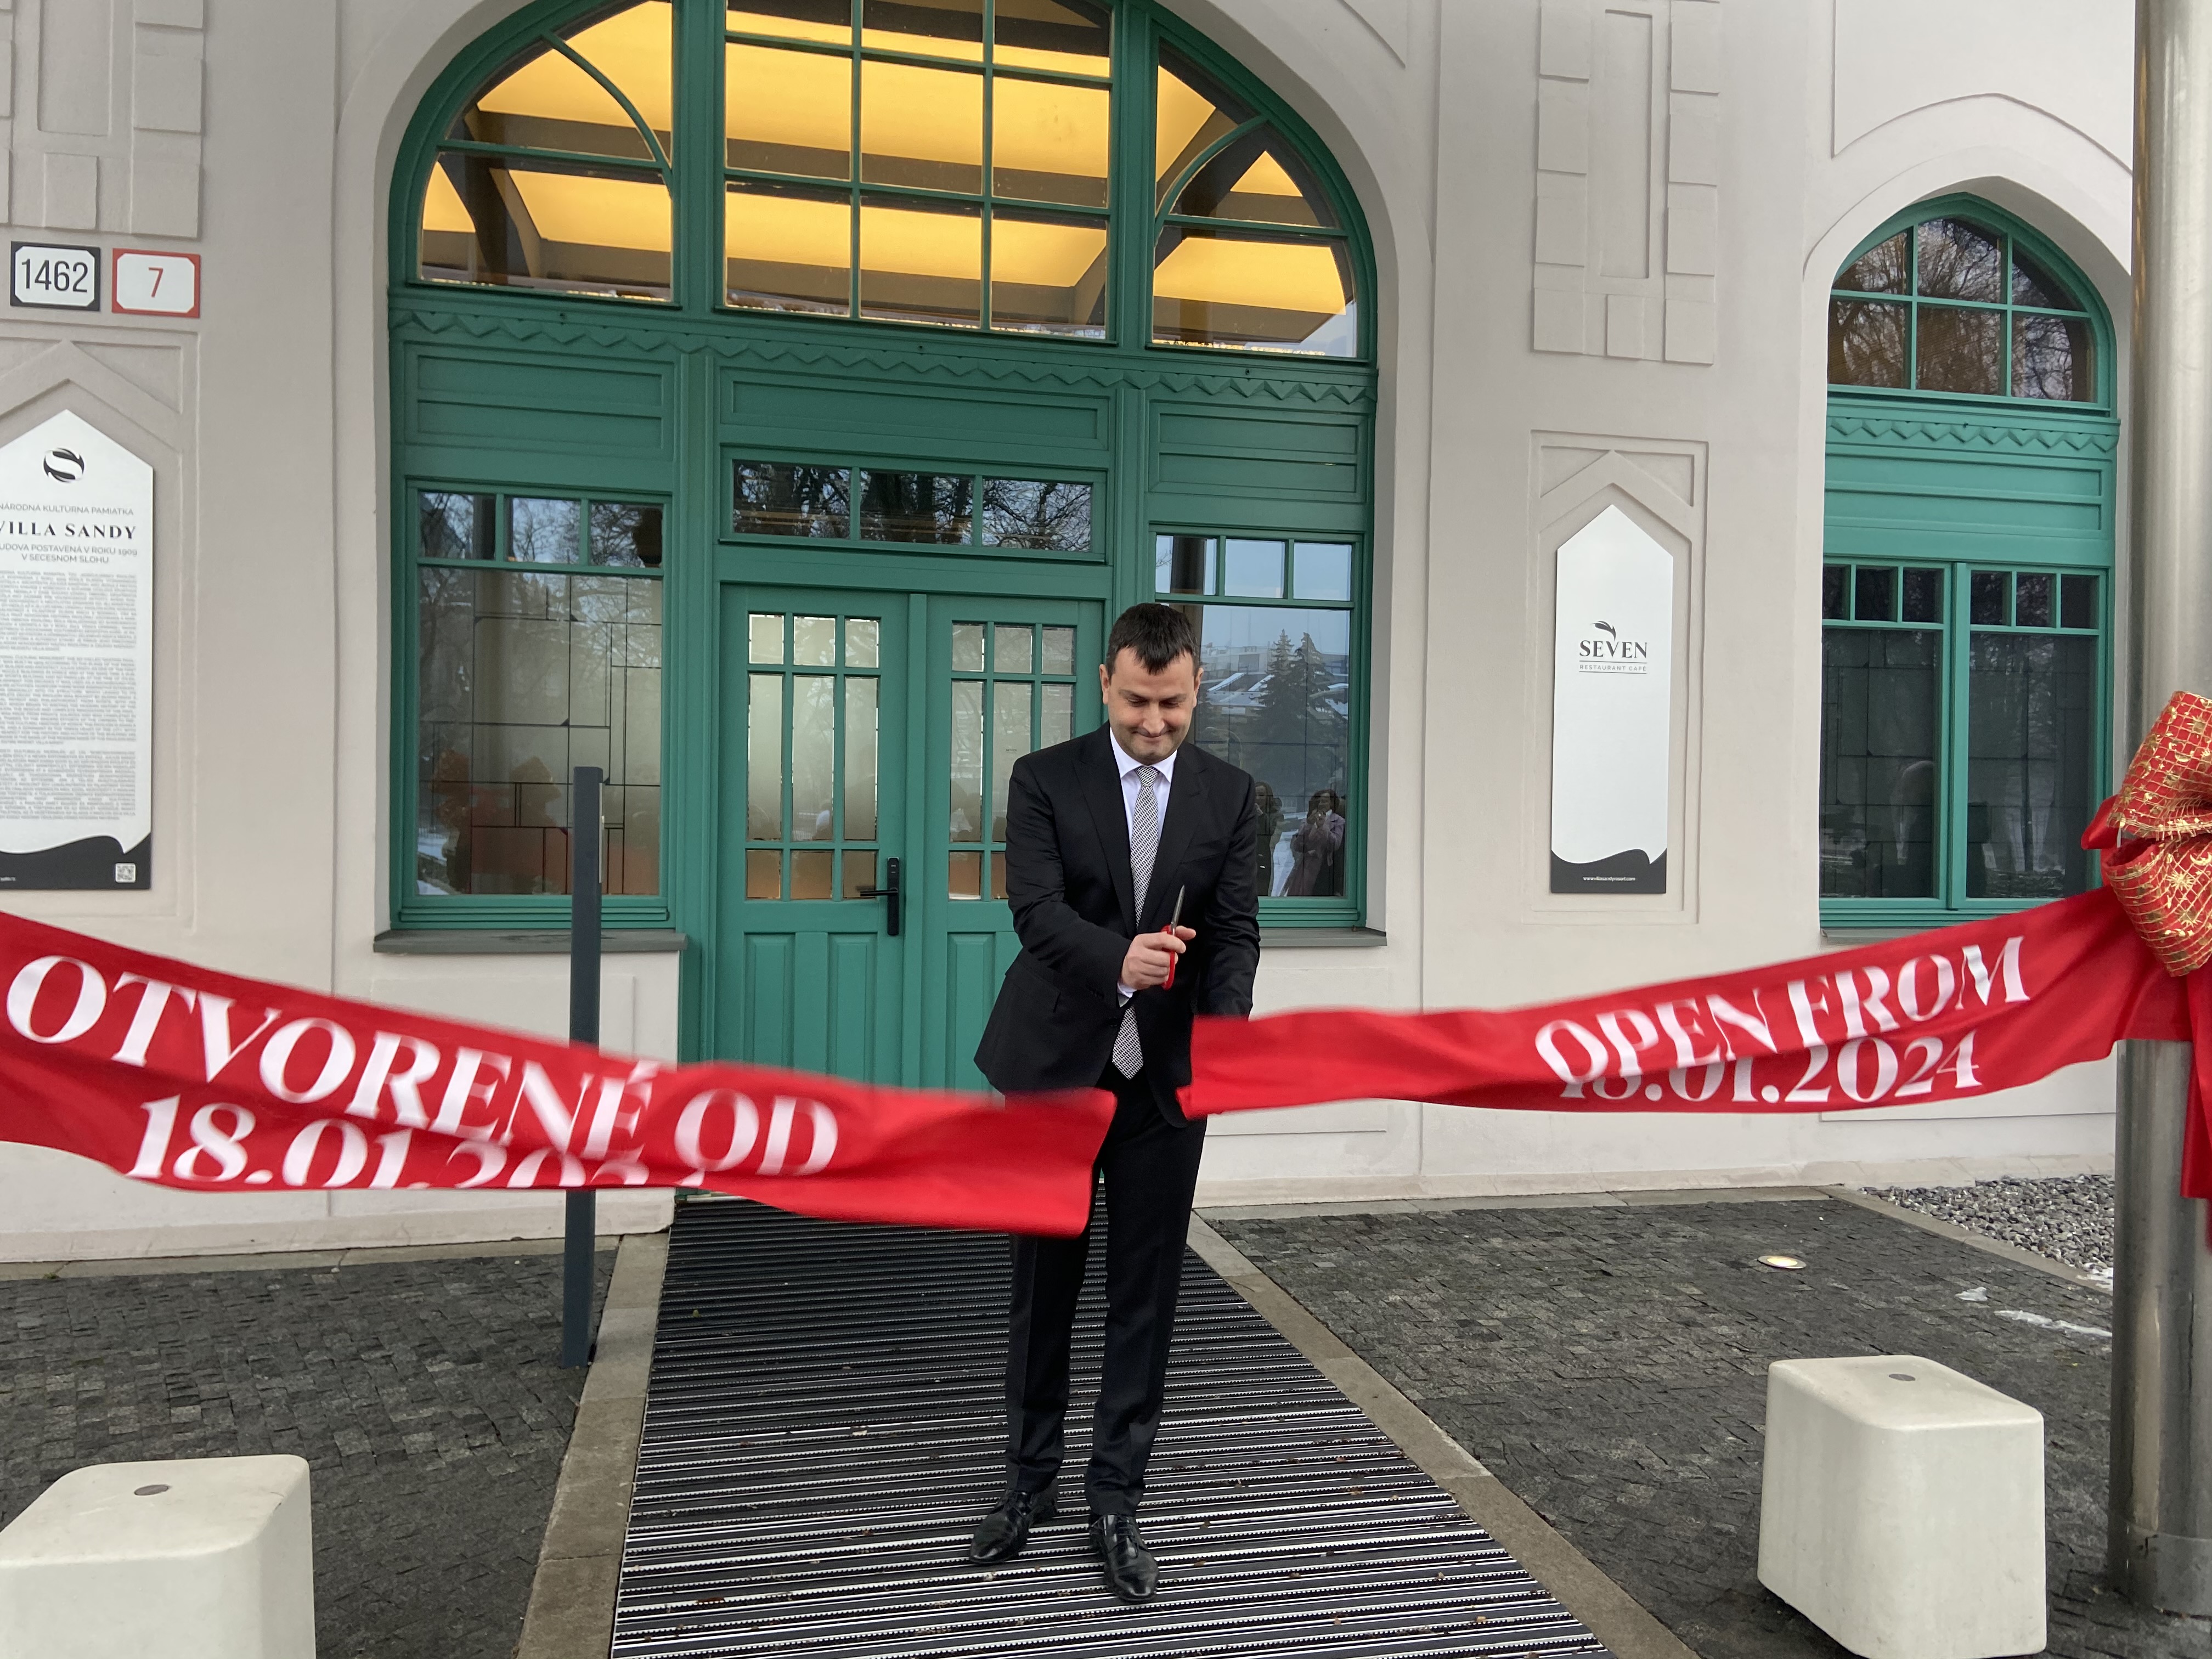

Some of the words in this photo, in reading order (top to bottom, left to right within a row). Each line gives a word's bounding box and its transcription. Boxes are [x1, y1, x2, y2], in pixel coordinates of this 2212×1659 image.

[21, 258, 88, 292] 1462
[148, 267, 163, 297] 7
[91, 506, 134, 515] PAMIATKA
[65, 523, 136, 539] SANDY
[0, 543, 29, 551] UDOVA
[92, 546, 116, 555] ROKU
[1579, 640, 1647, 658] SEVEN
[1536, 988, 1779, 1084] OPEN
[1787, 936, 2030, 1048] FROM
[7, 955, 659, 1160] OTVORENÉ
[674, 1088, 838, 1176] OD
[1560, 1030, 1982, 1103] .01.2024
